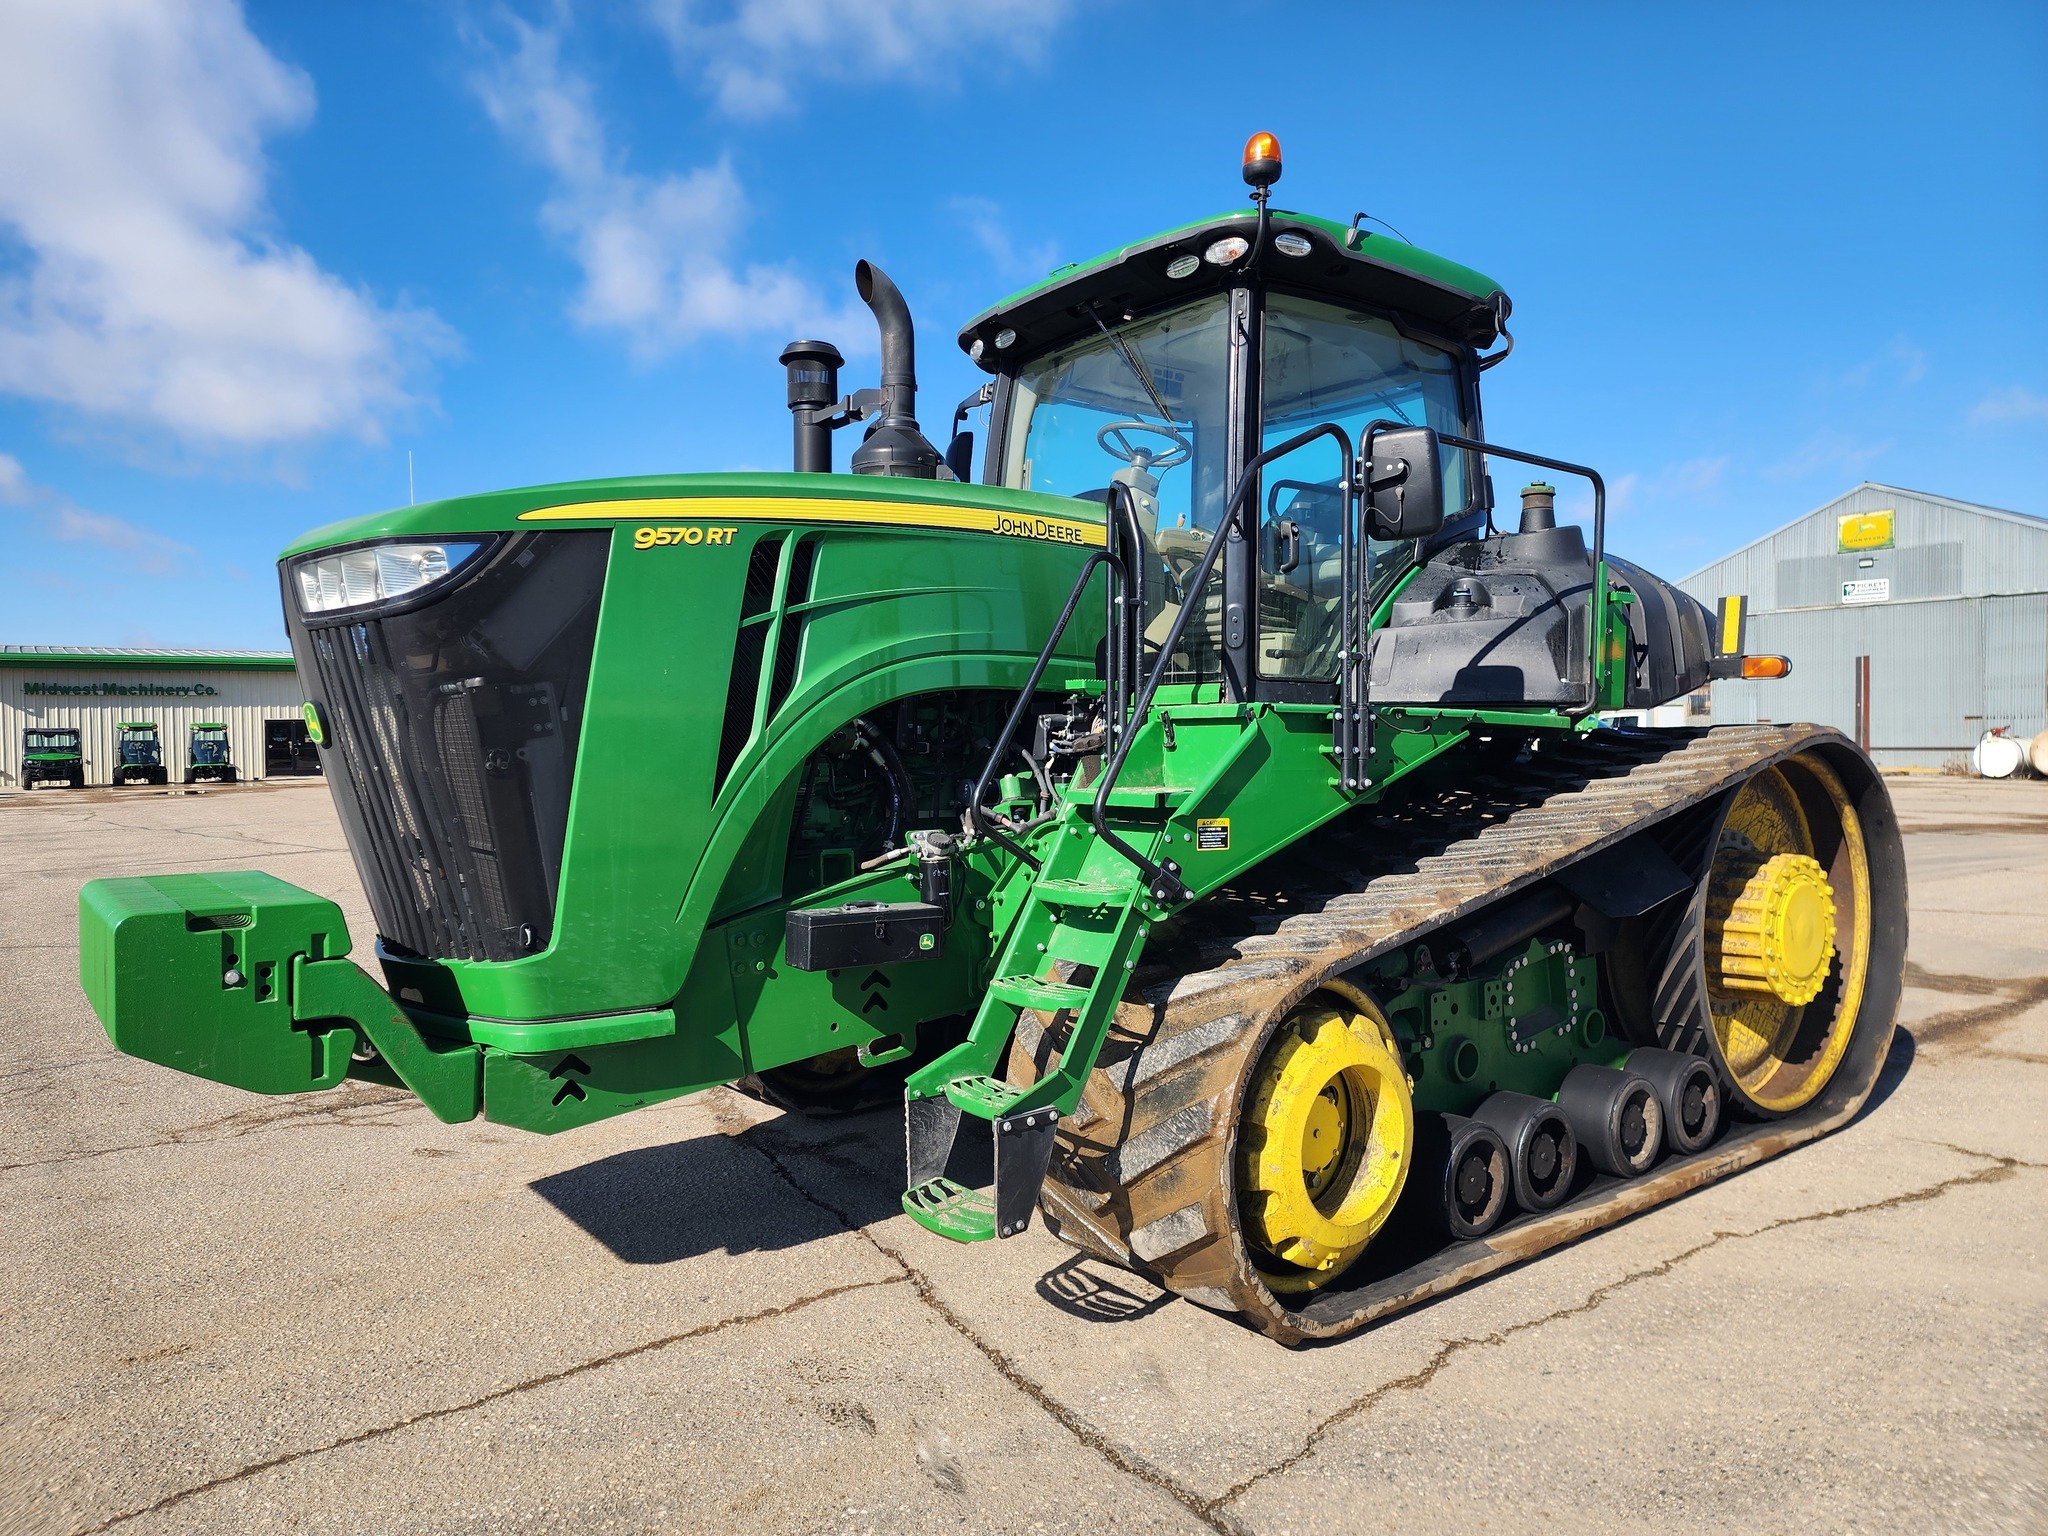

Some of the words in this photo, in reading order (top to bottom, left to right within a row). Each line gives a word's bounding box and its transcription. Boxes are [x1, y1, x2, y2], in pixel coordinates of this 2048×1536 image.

[634, 527, 704, 550] 9570
[706, 527, 739, 546] RT
[992, 515, 1033, 536] JOHN
[1035, 519, 1083, 542] DEERE
[23, 682, 98, 696] Midwest
[102, 682, 190, 698] Machinery
[193, 683, 218, 696] Co.
